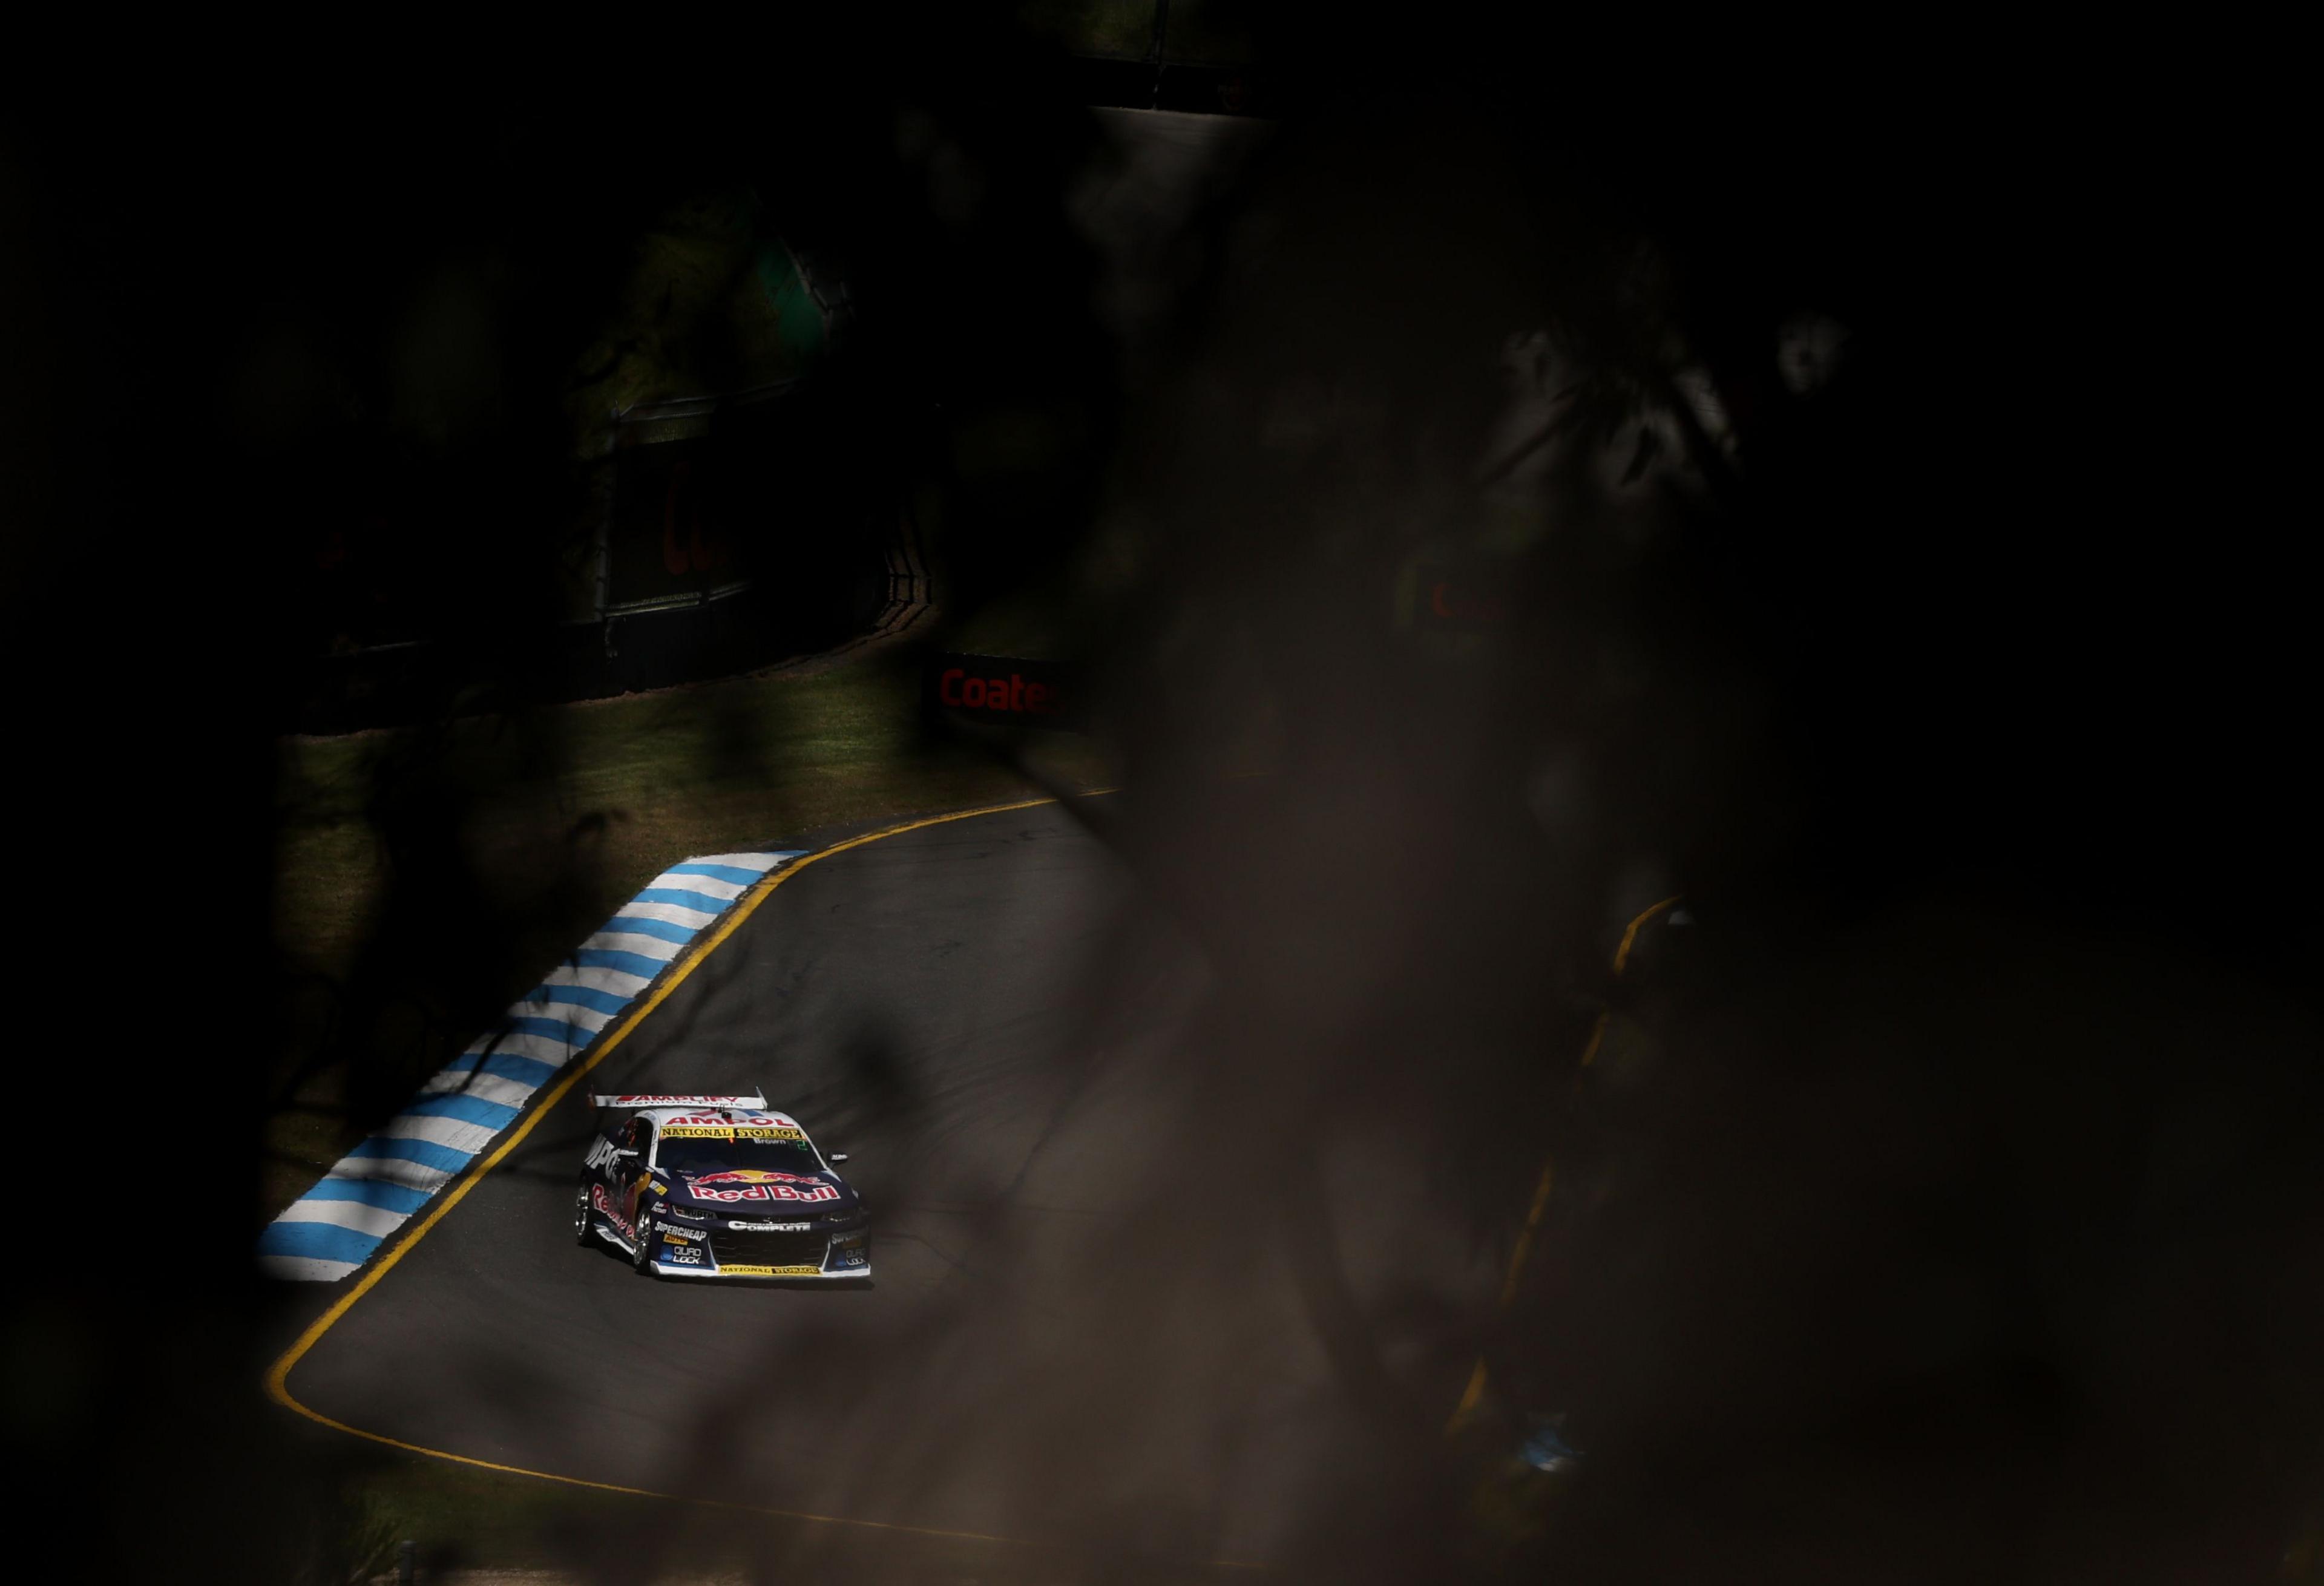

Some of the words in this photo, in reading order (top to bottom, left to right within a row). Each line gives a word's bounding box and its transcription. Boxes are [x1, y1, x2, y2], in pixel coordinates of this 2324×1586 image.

[666, 1116, 794, 1127] AMPOL
[663, 1127, 732, 1137] NATIONAL
[737, 1129, 800, 1138] STORAGE
[688, 1185, 770, 1203] Red
[767, 1185, 841, 1203] Bull
[654, 1221, 707, 1242] SUPERCHEAP
[728, 1221, 811, 1232] COMPLETE
[674, 1247, 702, 1257] QUAD
[672, 1255, 700, 1265] LOCK
